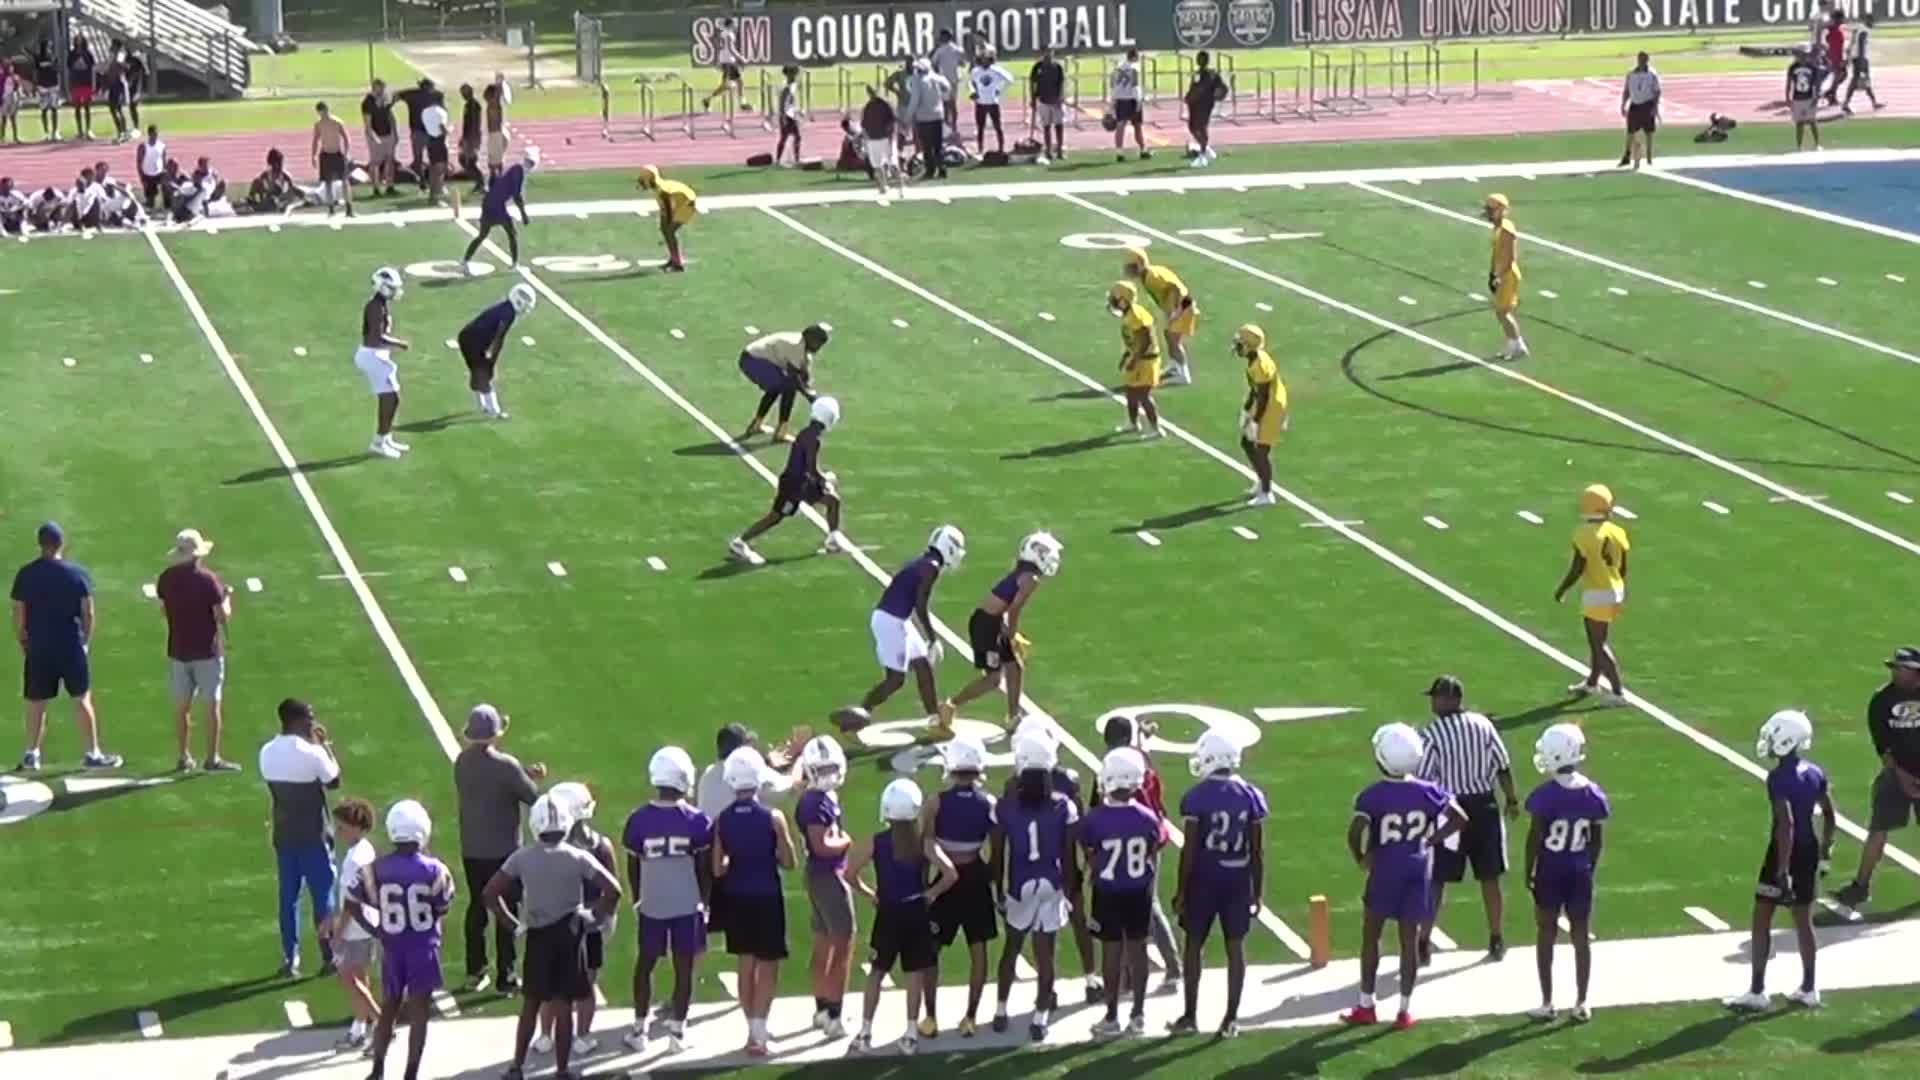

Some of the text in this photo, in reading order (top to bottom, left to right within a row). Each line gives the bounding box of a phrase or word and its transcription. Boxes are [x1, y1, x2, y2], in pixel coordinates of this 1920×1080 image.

[791, 11, 934, 60] COUGAR
[955, 4, 1137, 53] FOOTBALL
[1291, 0, 1403, 42] LHSAA
[1420, 0, 1571, 38] DIVISION
[1634, 0, 1740, 28] STATE
[1027, 820, 1040, 862] 1
[1099, 836, 1147, 880] 78
[380, 883, 433, 934] 66
